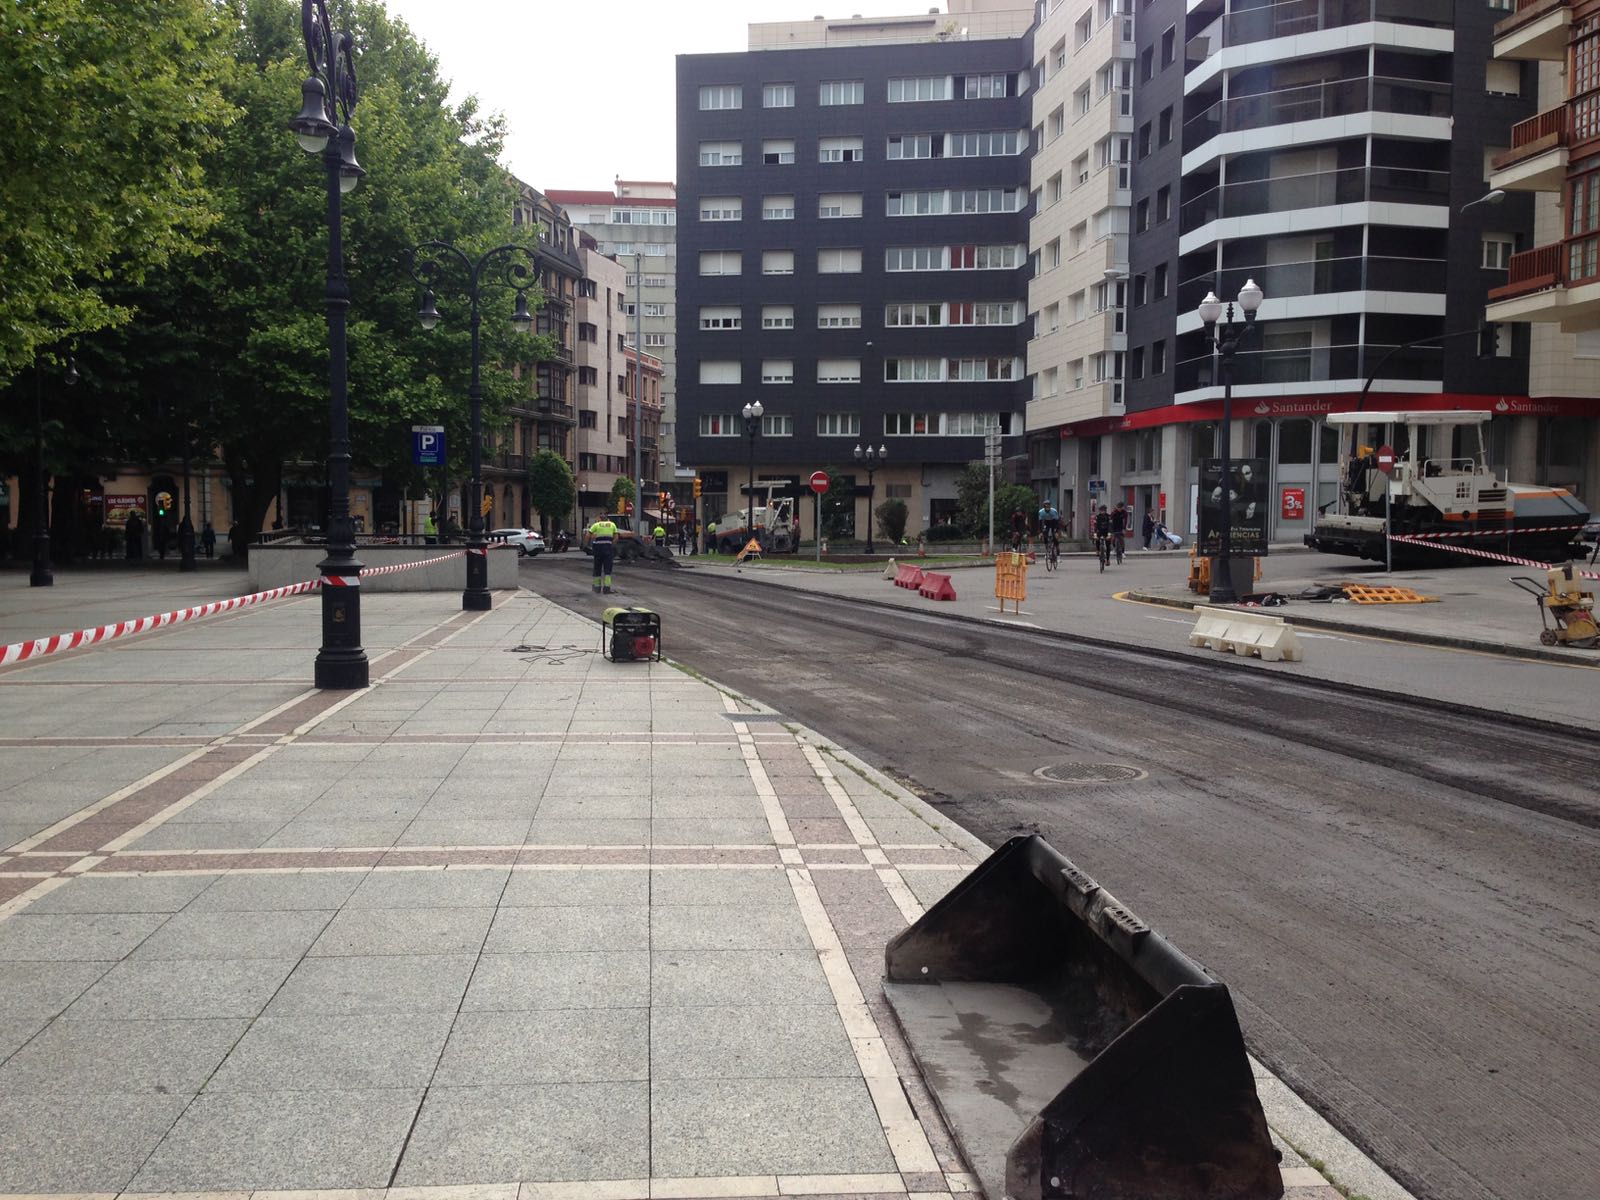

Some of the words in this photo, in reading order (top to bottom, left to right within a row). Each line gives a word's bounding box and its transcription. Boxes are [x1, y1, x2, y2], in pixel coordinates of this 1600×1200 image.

[1272, 400, 1332, 413] Santander
[1510, 400, 1560, 413] Santander
[422, 434, 435, 450] P
